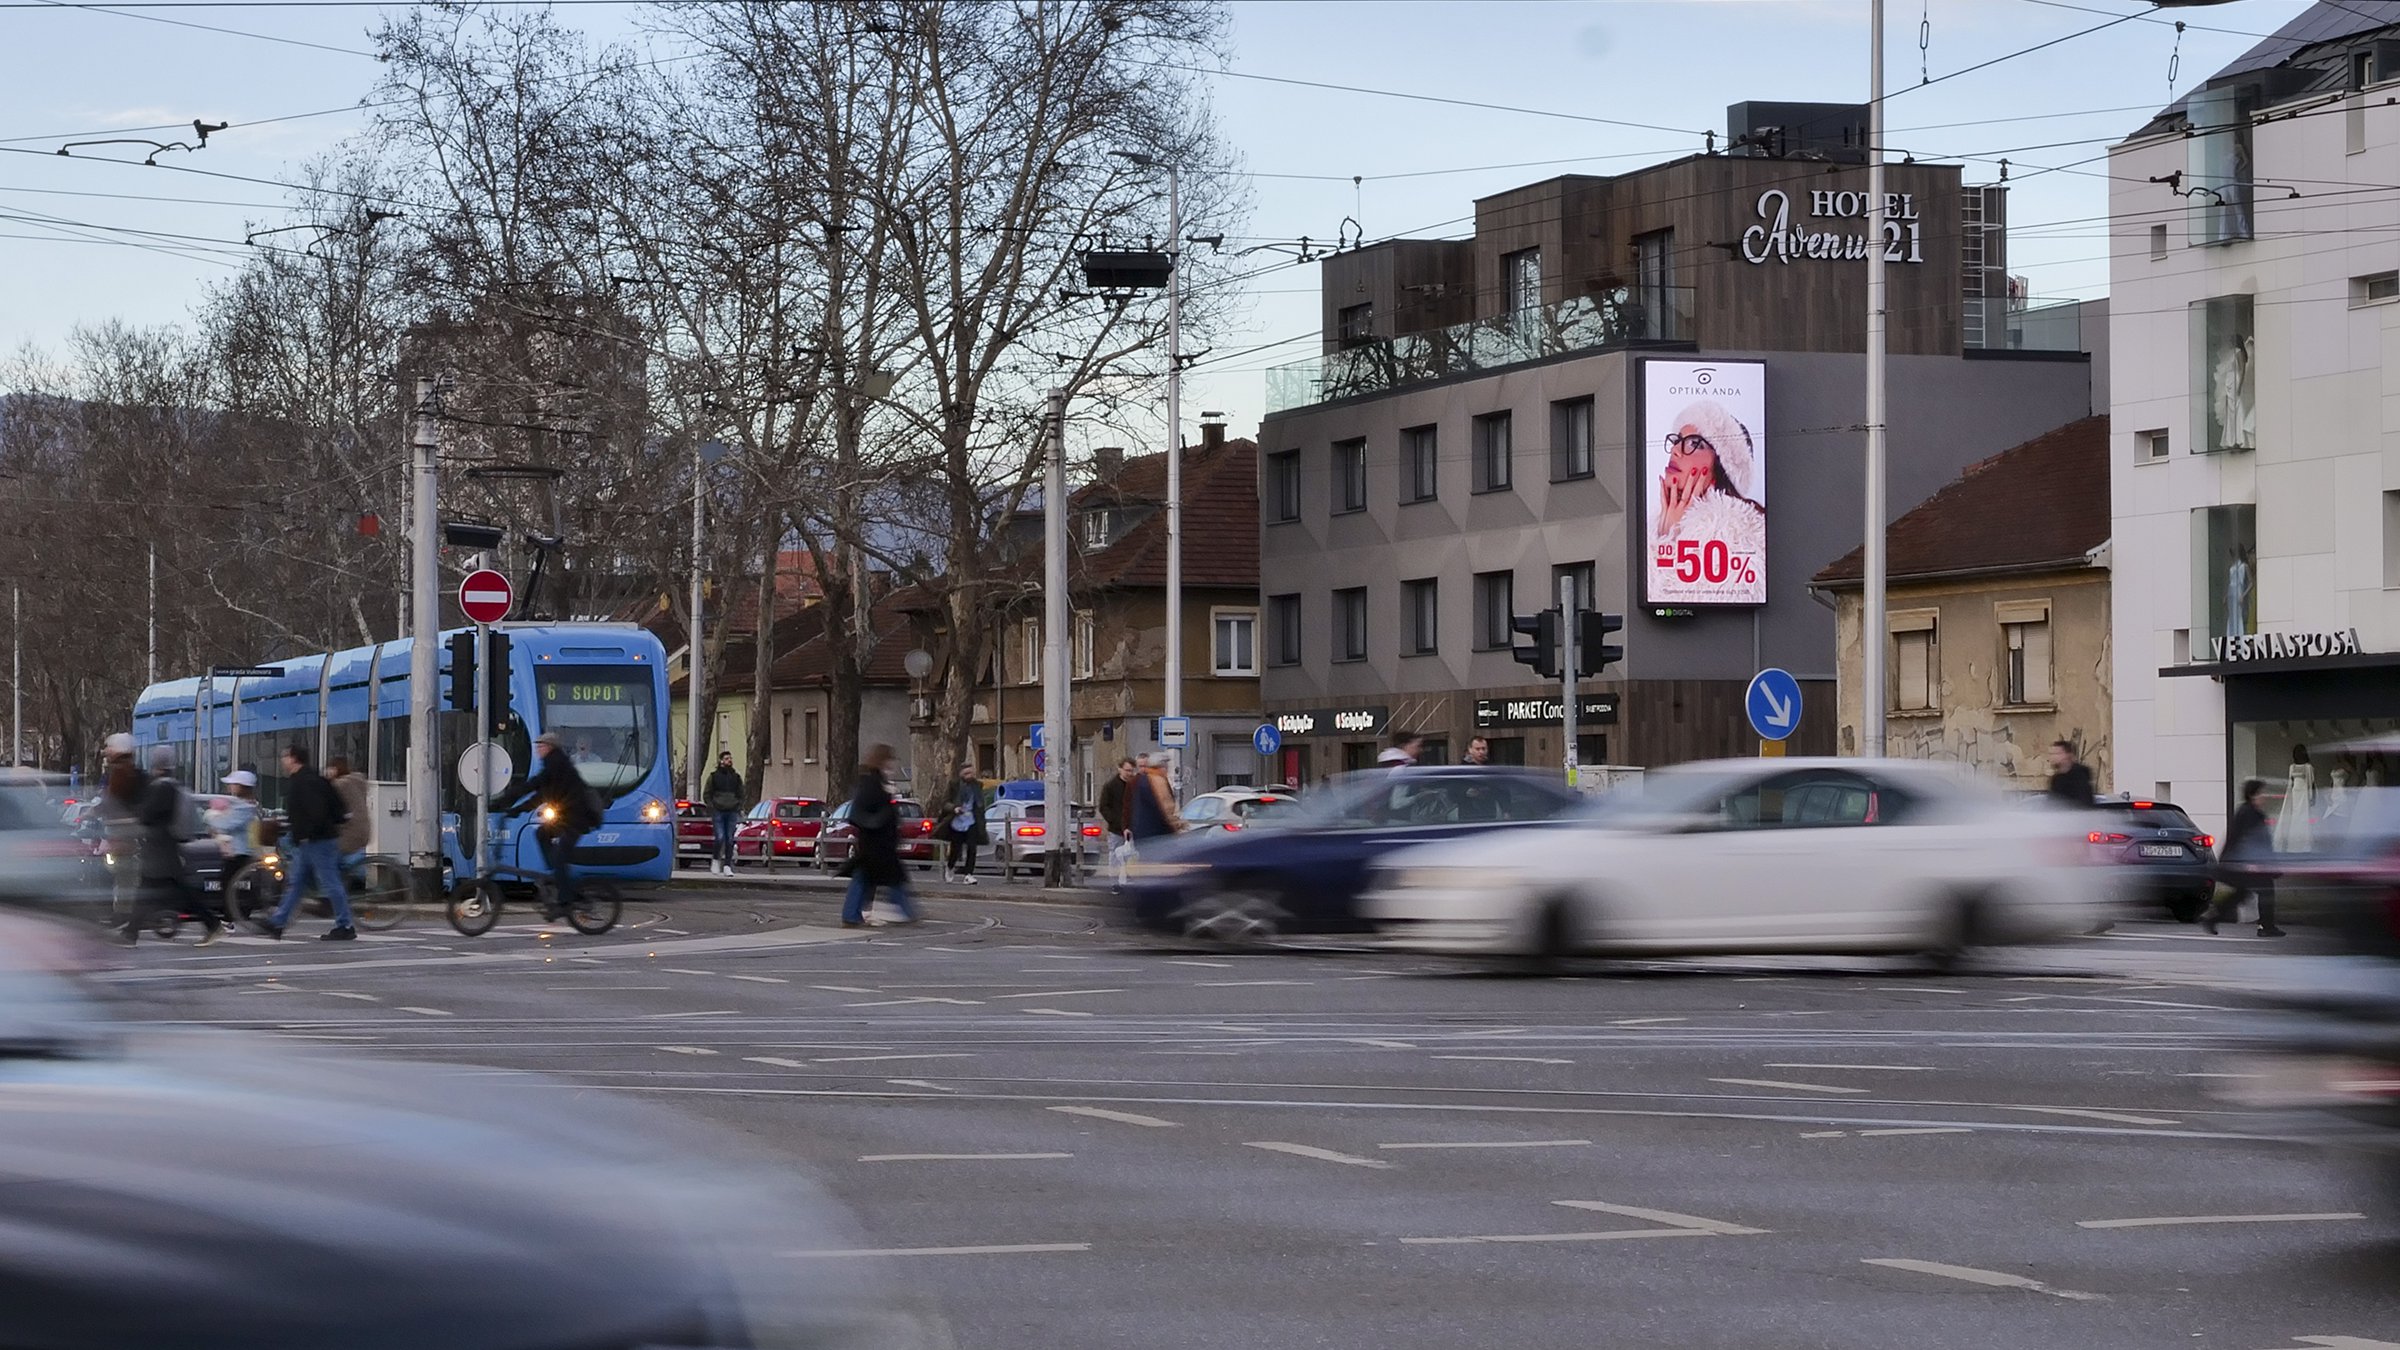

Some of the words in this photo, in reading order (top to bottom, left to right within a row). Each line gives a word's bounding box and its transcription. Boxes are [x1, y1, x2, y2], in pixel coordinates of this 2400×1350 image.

[1883, 220, 1924, 263] 21
[1669, 386, 1708, 396] OPTIKA
[1712, 387, 1741, 397] ANDA
[547, 683, 556, 701] 6
[573, 685, 622, 701] SOPOT
[1507, 701, 1542, 720] PARKET
